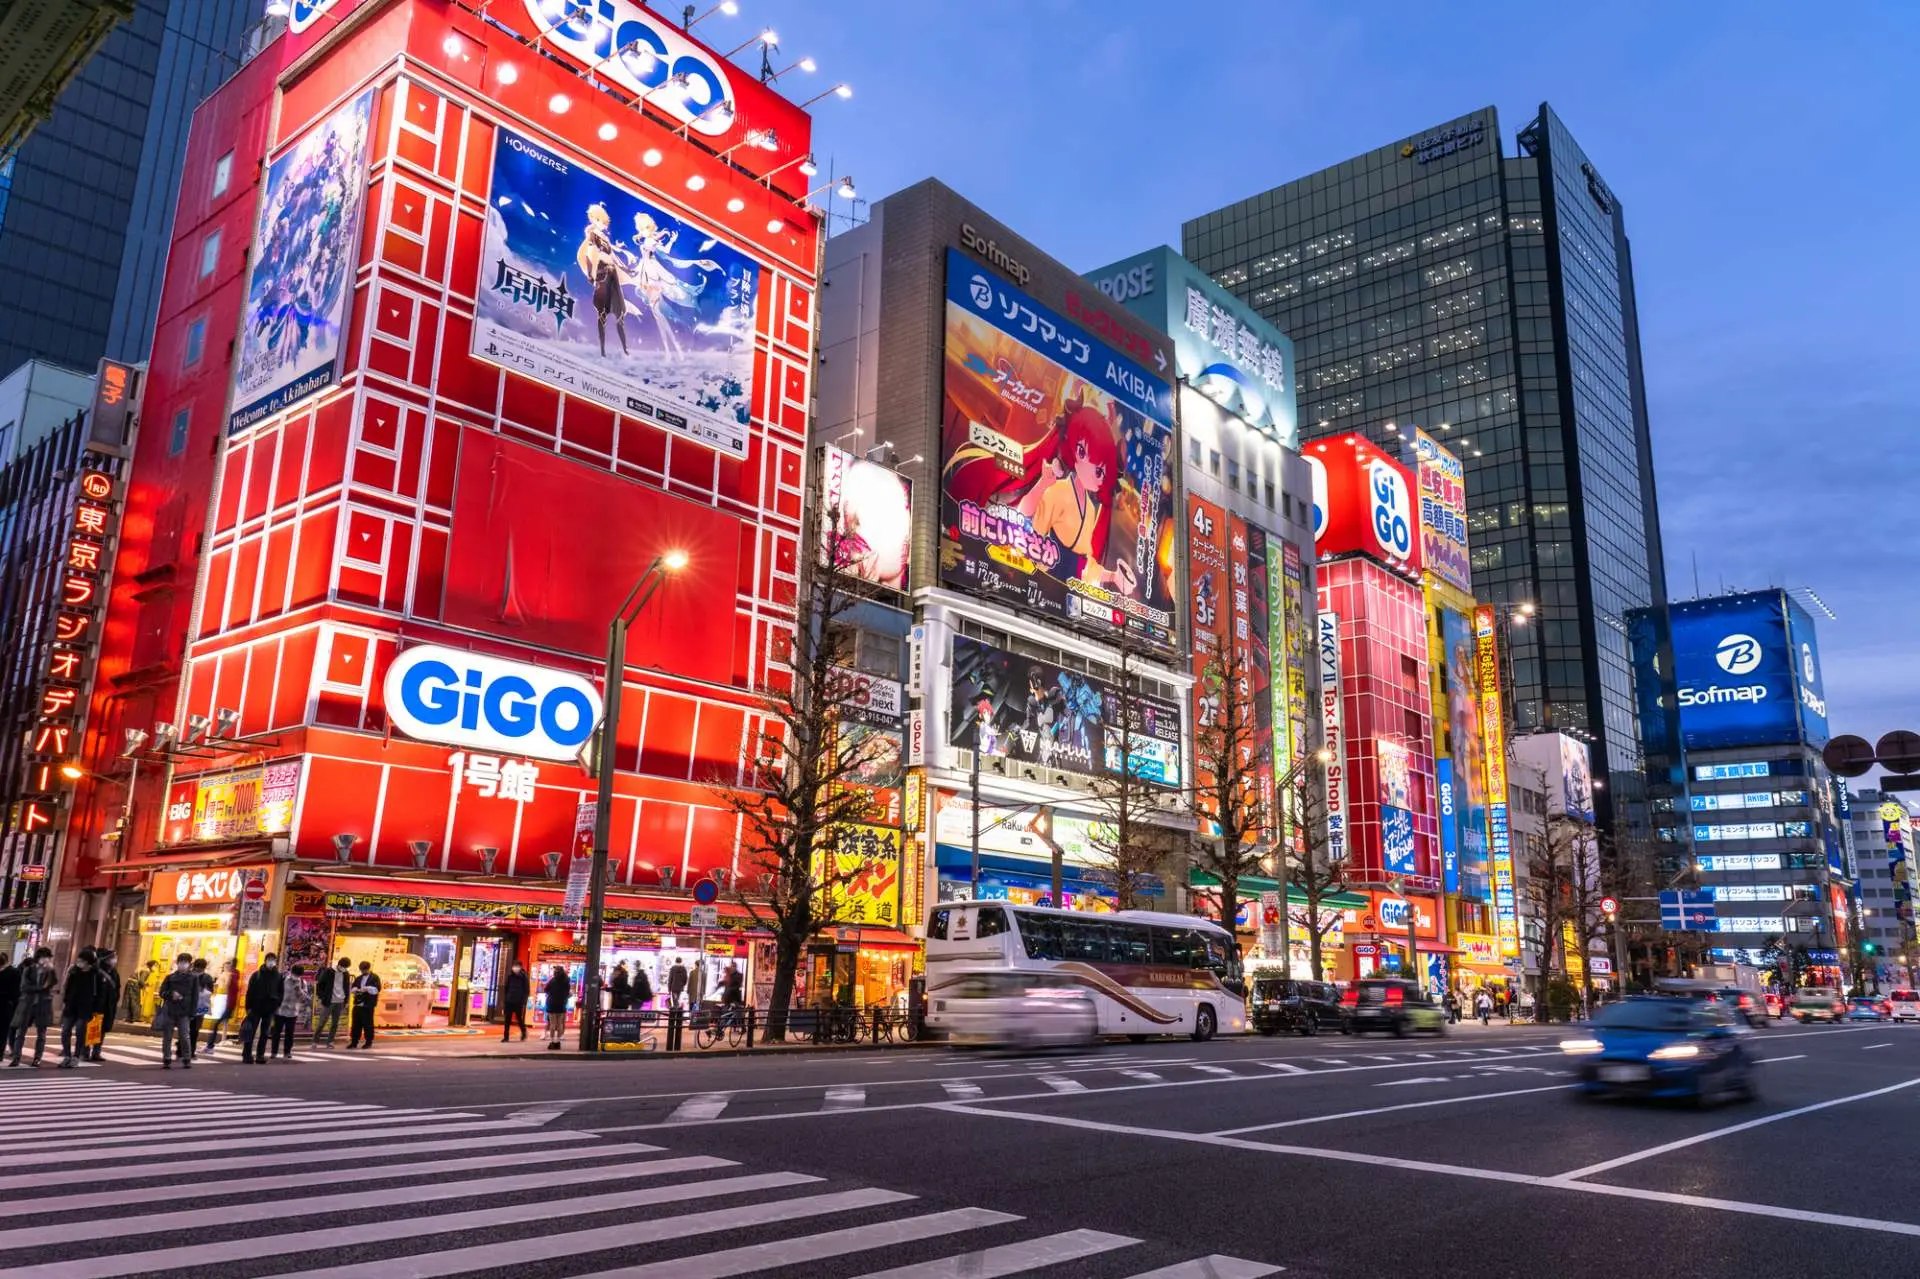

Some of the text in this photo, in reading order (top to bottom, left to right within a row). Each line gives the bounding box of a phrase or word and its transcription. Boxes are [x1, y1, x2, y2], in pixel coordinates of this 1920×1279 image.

[961, 222, 1031, 287] Sofmap
[491, 257, 576, 335] 原神
[999, 291, 1091, 365] ソフマップ
[500, 350, 575, 385] PS5 PS4
[1106, 361, 1158, 409] AKIBA
[232, 370, 331, 431] Welcome to Akihabara
[580, 381, 621, 404] Windows
[1193, 507, 1213, 538] 4F
[1196, 595, 1215, 628] 3F
[1319, 618, 1336, 671] AKKY
[24, 504, 106, 832] 東京ラジオデパート
[401, 660, 594, 747] GiGO
[871, 698, 895, 712] next
[1677, 684, 1768, 707] Sofmap
[912, 719, 922, 754] GPS
[447, 752, 540, 803] 1号館
[1326, 764, 1343, 813] Shop
[1440, 784, 1454, 816] GiGO
[1747, 793, 1770, 804] AKIBA
[189, 871, 229, 901] 宝くじ
[1603, 901, 1616, 911] 50
[1355, 945, 1376, 955] GiGO
